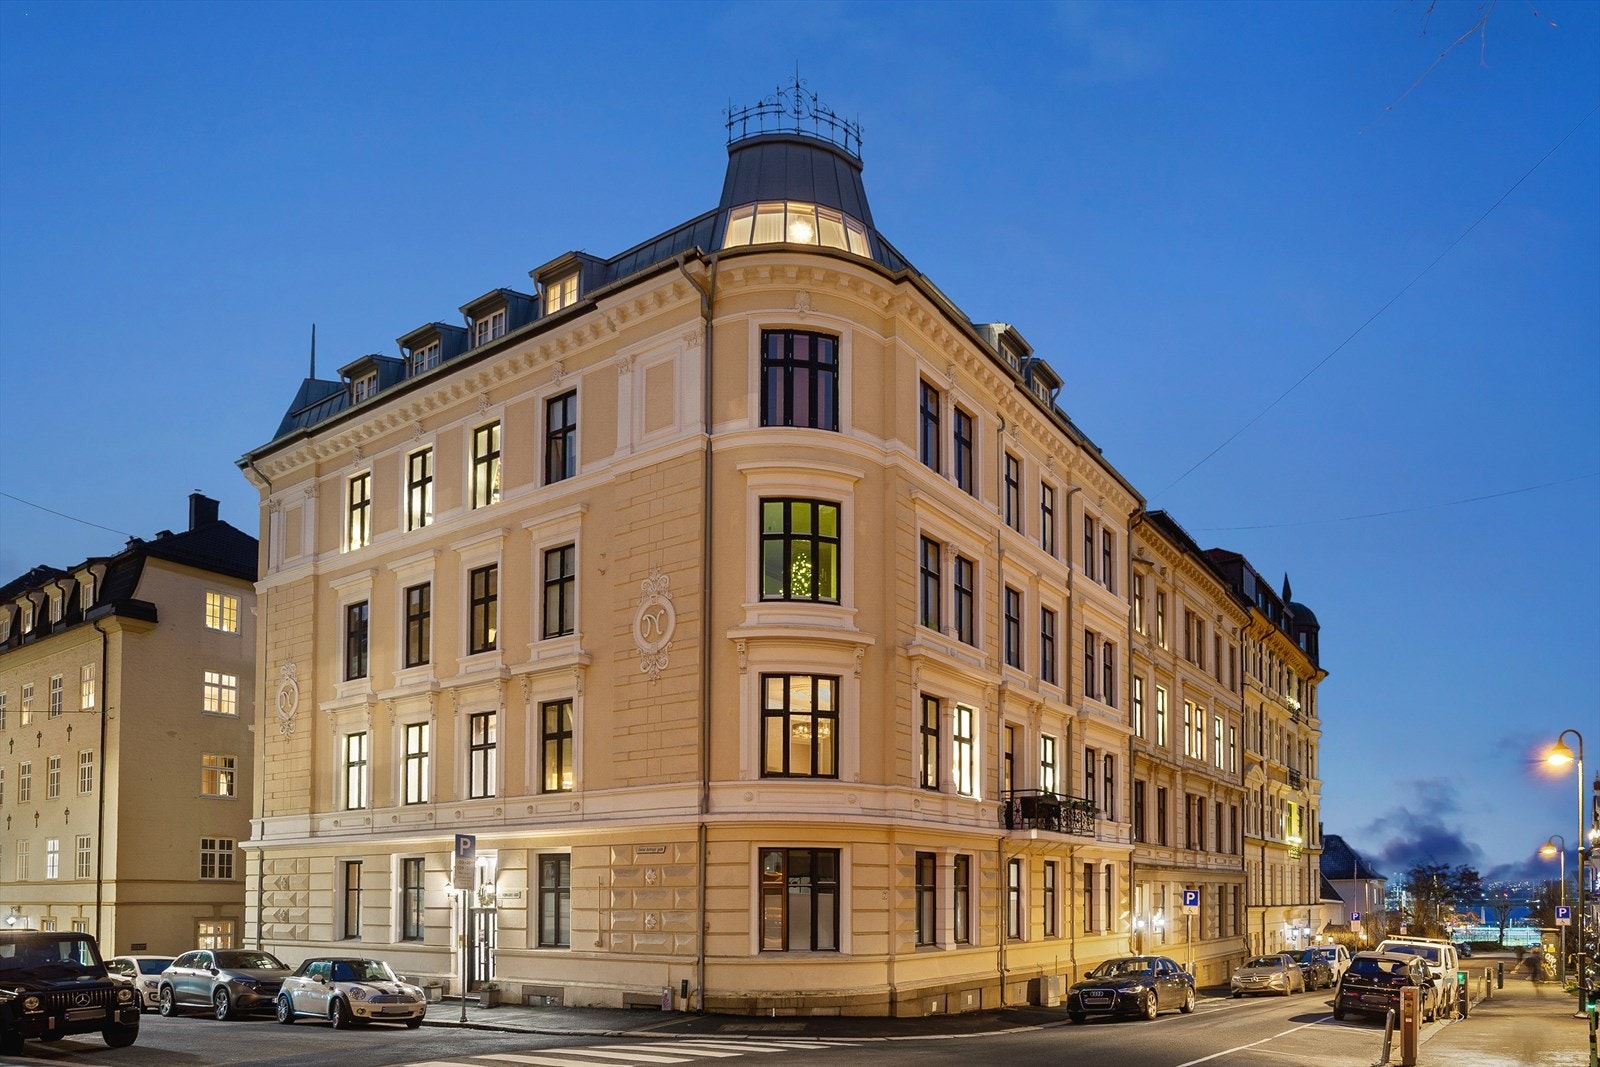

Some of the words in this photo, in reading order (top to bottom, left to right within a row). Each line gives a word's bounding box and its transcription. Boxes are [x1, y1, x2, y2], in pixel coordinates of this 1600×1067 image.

[459, 837, 471, 856] P
[1186, 892, 1196, 905] P
[1559, 908, 1567, 917] P
